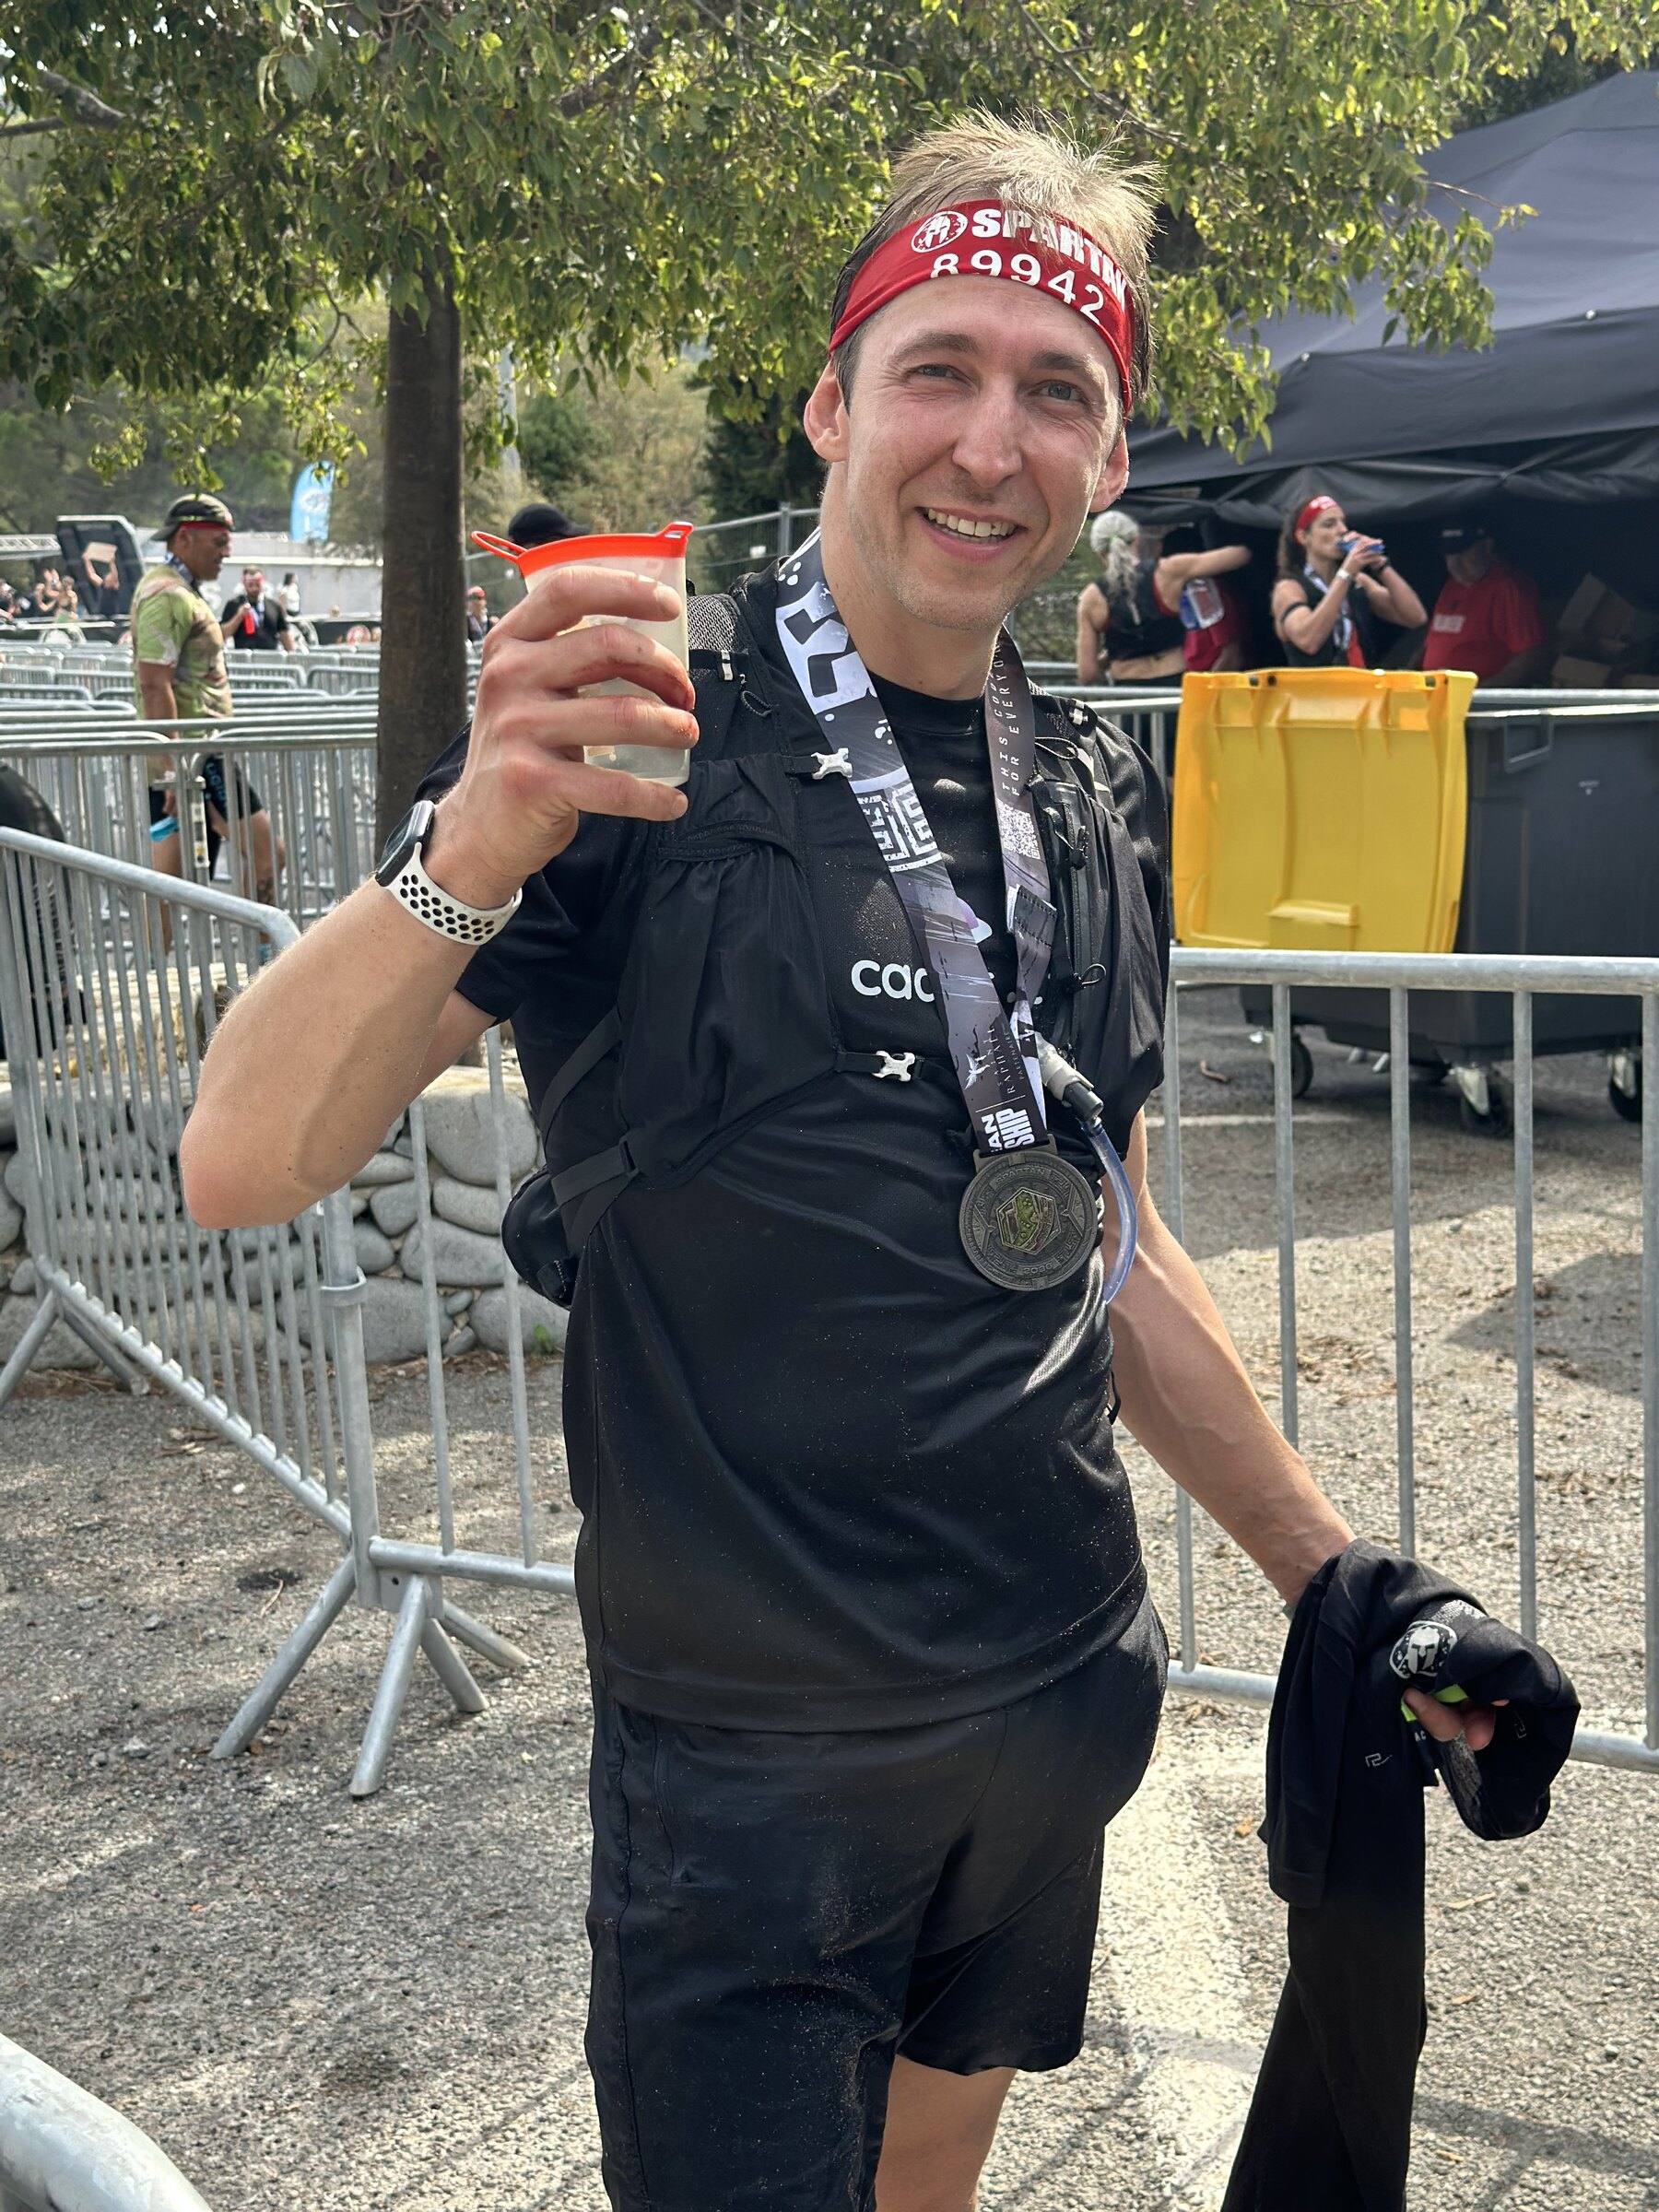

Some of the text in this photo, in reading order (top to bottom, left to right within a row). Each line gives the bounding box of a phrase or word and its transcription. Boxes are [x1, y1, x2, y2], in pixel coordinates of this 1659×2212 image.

[971, 208, 1128, 312] SPARTAN
[930, 250, 1104, 324] 89942
[998, 736, 1011, 792] THIS
[1010, 757, 1020, 797] FOR
[981, 1113, 1003, 1152] AN
[995, 1108, 1035, 1149] SHIP
